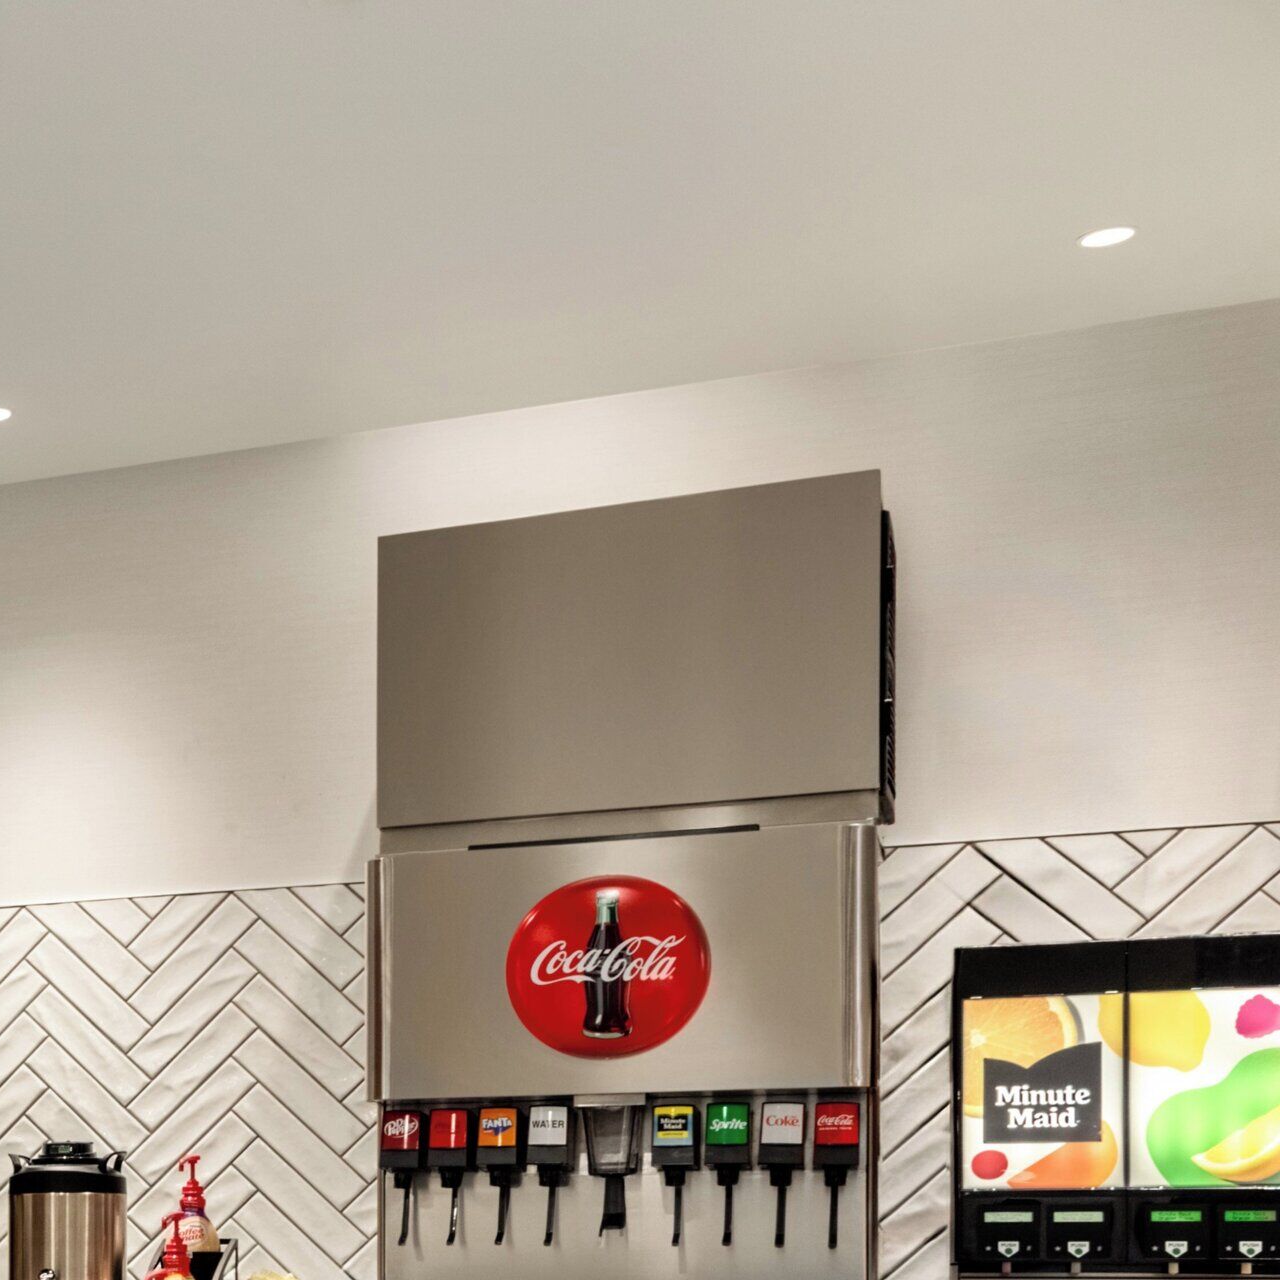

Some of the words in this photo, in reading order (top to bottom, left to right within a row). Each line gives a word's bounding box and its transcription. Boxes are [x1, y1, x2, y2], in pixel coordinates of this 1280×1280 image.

[530, 935, 687, 986] Coca-Cola
[994, 1084, 1092, 1106] Minute
[482, 1116, 512, 1128] FANTA
[532, 1119, 565, 1129] WATER
[765, 1114, 799, 1127] Coke
[817, 1113, 855, 1126] Coca-Cola
[1006, 1106, 1078, 1129] Maid
[710, 1118, 748, 1132] Sprite
[179, 1227, 205, 1239] offee
